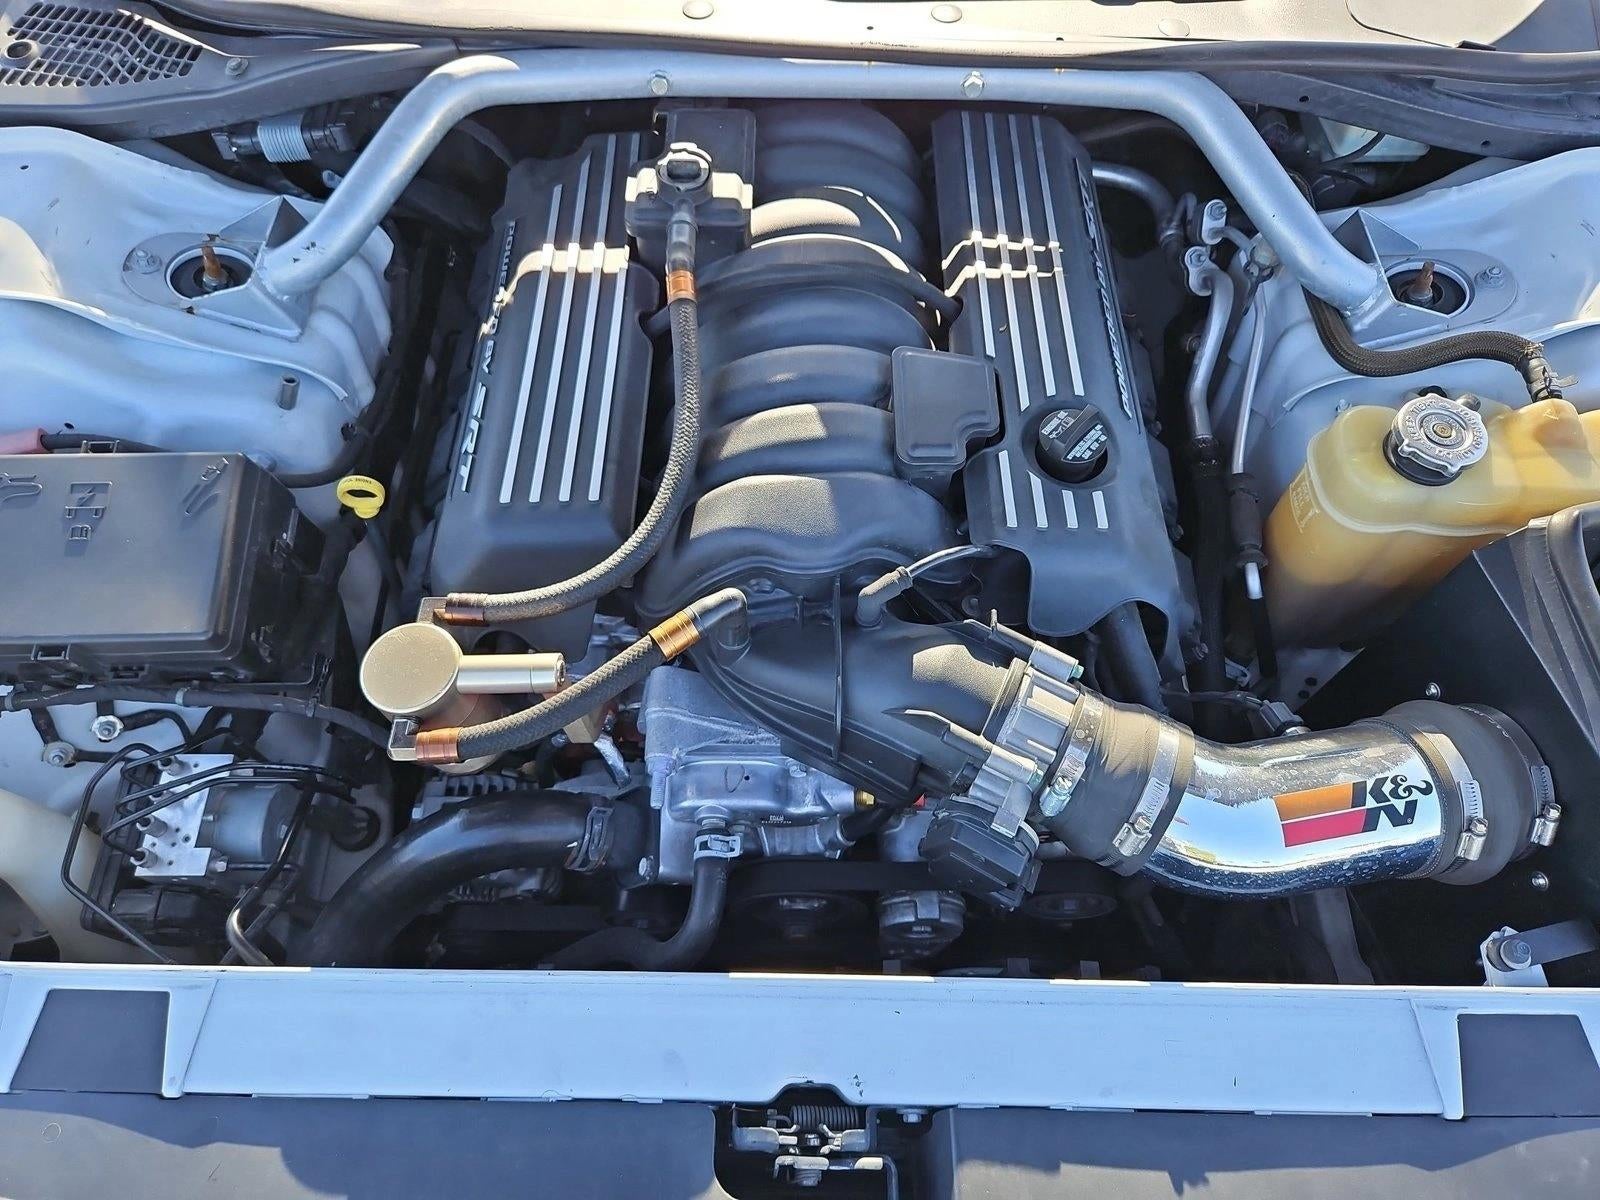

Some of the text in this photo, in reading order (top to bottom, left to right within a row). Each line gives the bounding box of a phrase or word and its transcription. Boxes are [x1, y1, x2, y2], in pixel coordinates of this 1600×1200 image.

[1075, 158, 1132, 420] POWERED BY SRT
[482, 340, 495, 374] BY
[459, 382, 488, 492] SRT
[1041, 417, 1062, 435] ENGINE
